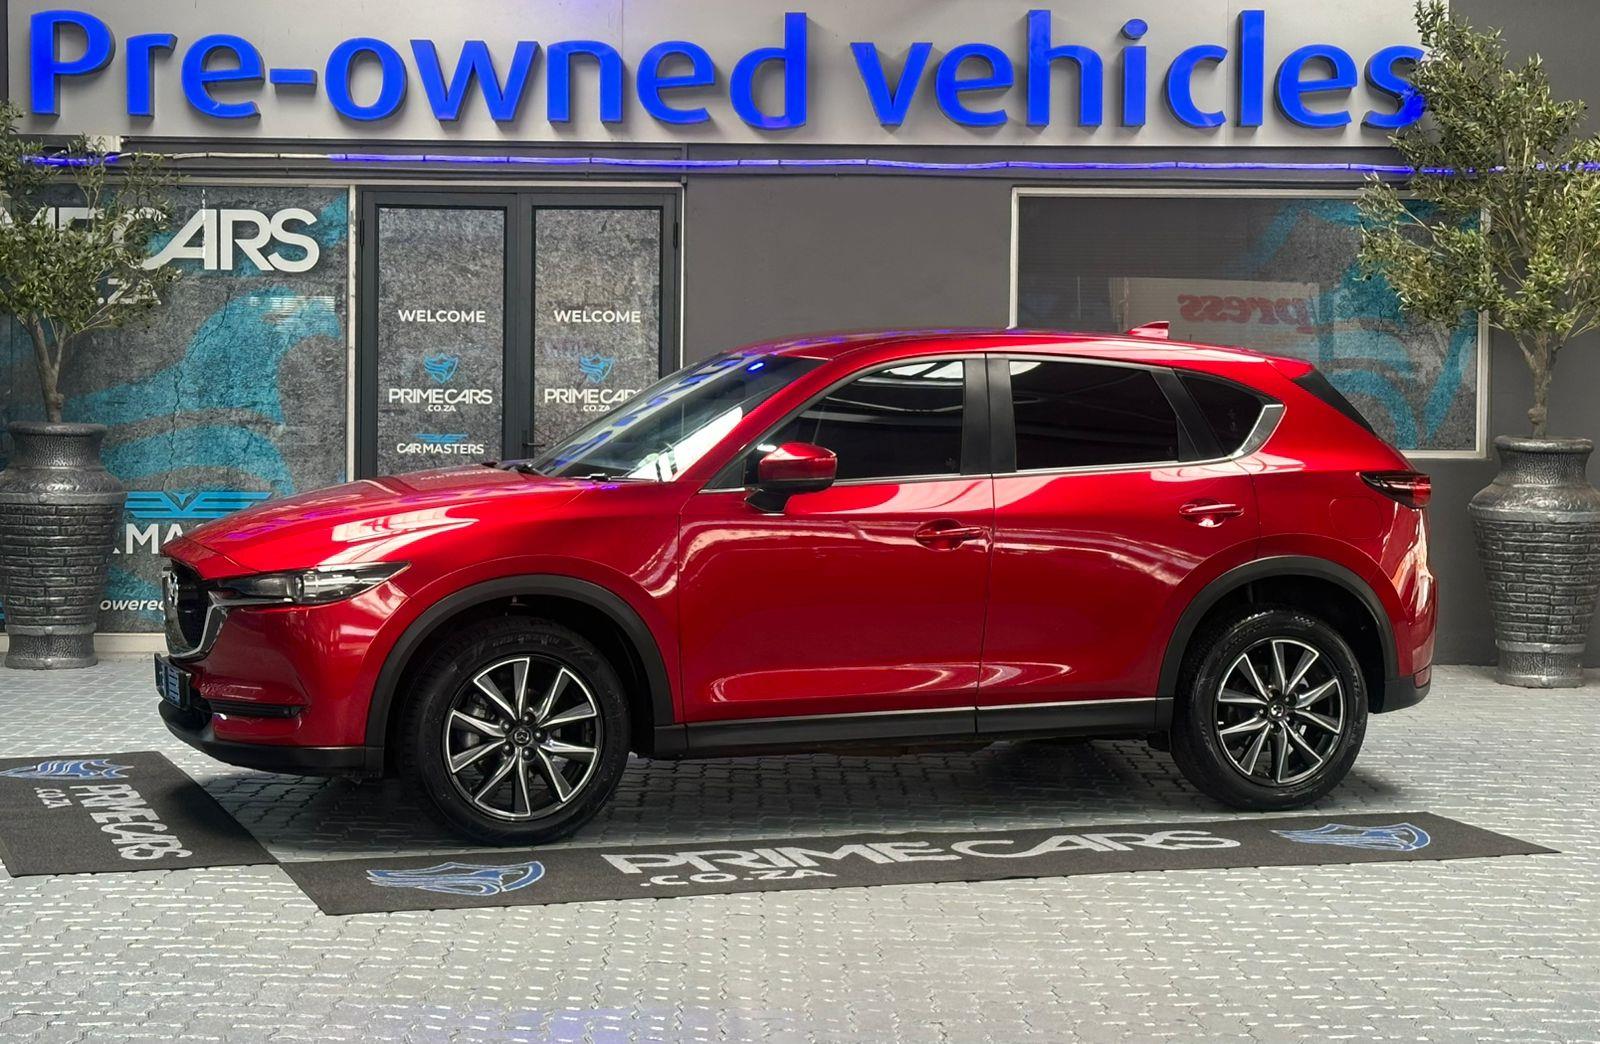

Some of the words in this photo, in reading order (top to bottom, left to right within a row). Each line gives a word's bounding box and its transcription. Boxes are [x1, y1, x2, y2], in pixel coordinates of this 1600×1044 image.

[29, 9, 807, 130] Pre-owned
[851, 9, 1427, 129] vehicles
[398, 309, 486, 323] WELCOME
[554, 310, 642, 323] WELCOME
[388, 388, 493, 404] PRIMECARS
[640, 869, 837, 887] .CO.ZA
